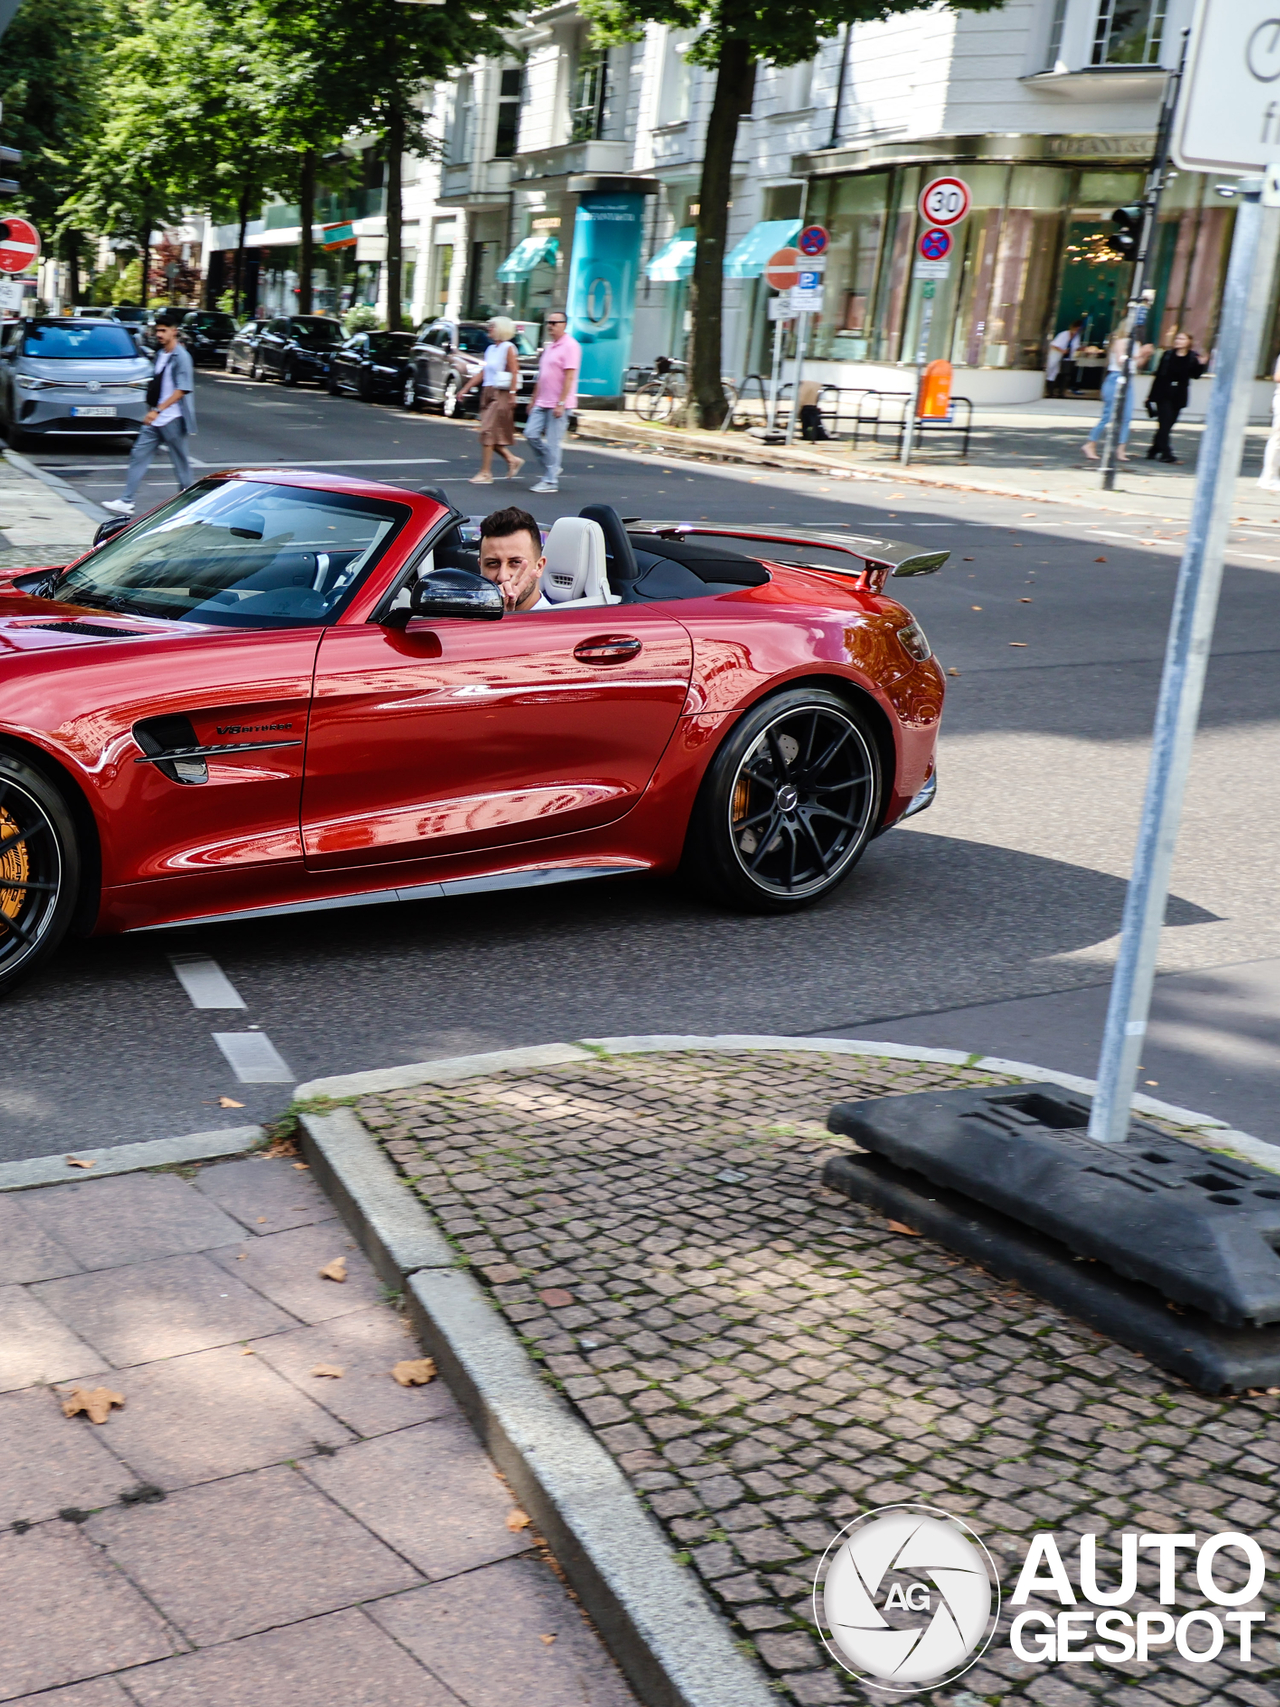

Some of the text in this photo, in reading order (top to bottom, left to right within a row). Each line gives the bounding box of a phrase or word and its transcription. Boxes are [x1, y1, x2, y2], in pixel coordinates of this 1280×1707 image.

[932, 191, 960, 213] 30
[216, 722, 293, 735] V8 BITURBO
